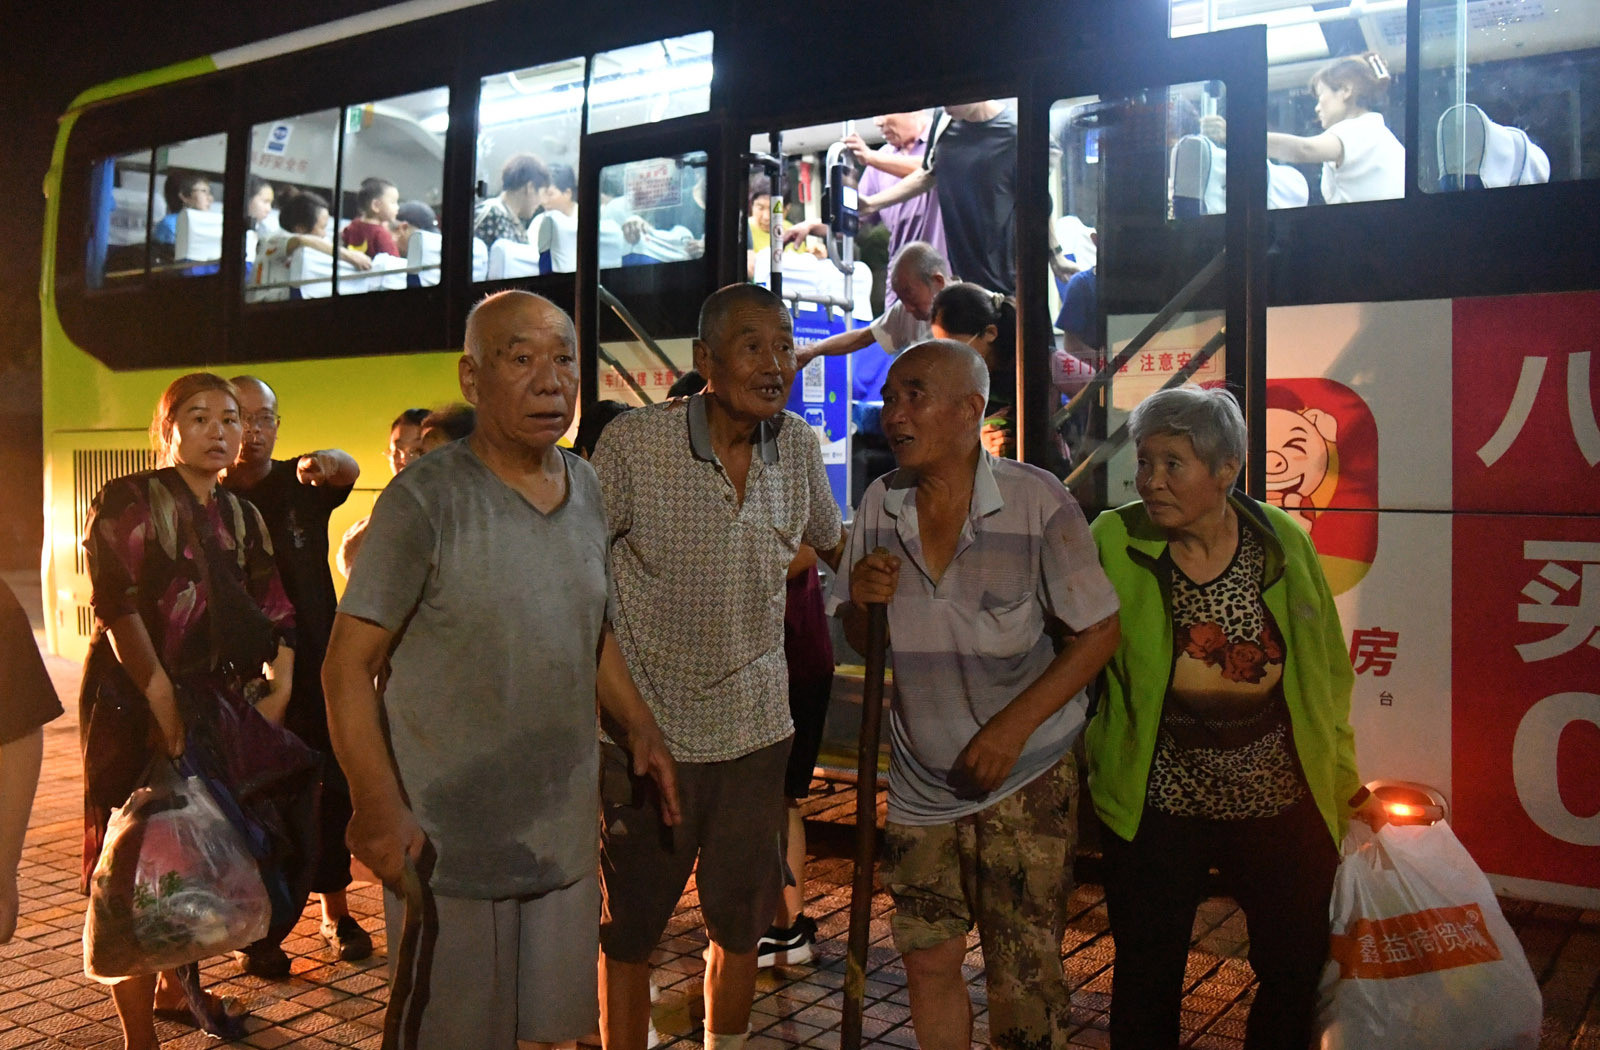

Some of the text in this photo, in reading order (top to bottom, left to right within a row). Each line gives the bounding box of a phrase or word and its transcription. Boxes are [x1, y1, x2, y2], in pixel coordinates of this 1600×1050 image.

[1140, 351, 1211, 372] 注意安全
[1475, 350, 1600, 468] 八
